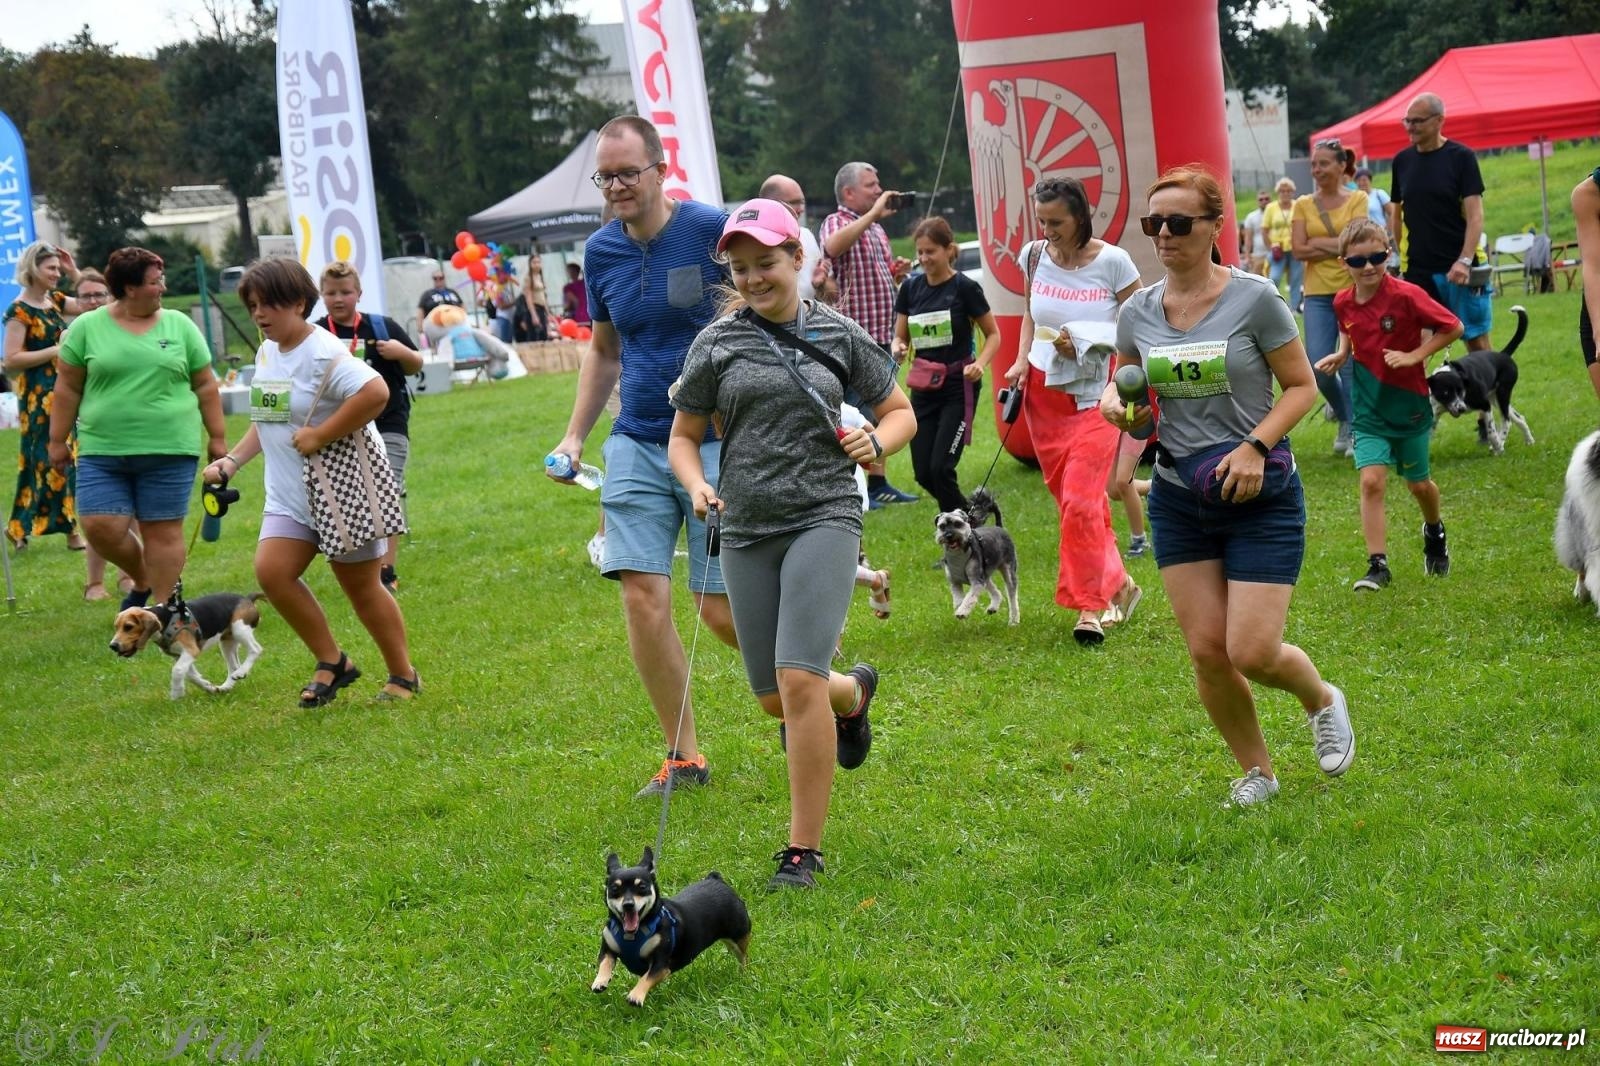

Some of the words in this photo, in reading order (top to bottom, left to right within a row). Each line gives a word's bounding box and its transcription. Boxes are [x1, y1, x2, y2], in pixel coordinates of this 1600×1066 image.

[922, 324, 938, 337] 41
[1172, 361, 1202, 382] 13
[416, 370, 426, 391] 2
[262, 393, 278, 407] 69
